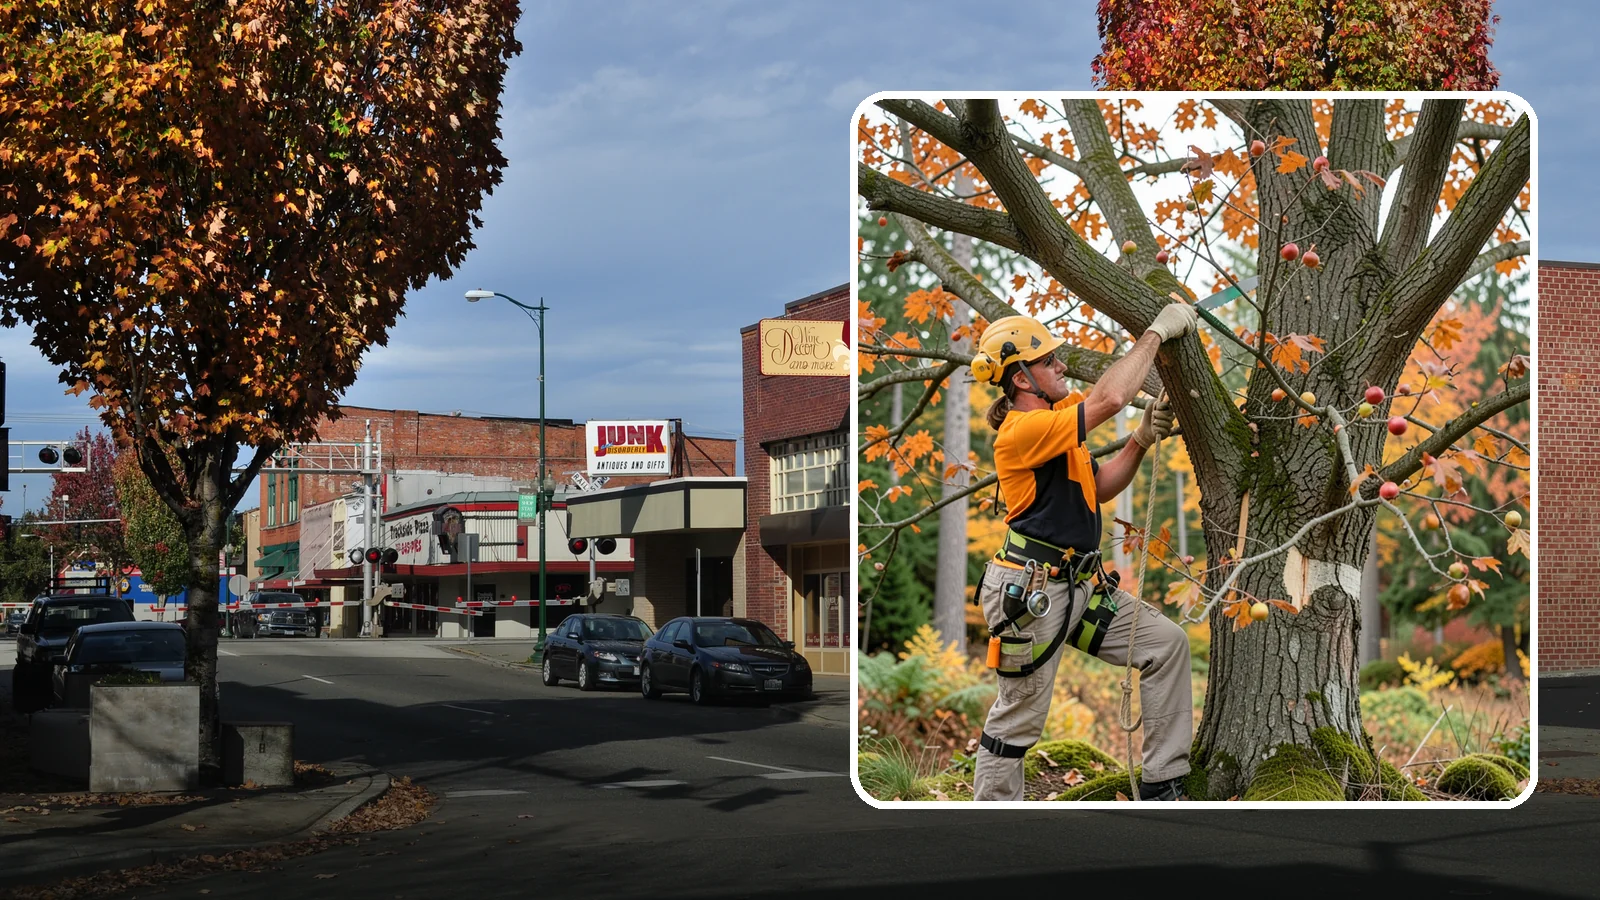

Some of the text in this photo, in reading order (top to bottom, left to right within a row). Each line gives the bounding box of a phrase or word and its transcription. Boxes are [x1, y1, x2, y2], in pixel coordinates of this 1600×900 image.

[765, 327, 831, 366] Decor
[595, 425, 665, 457] JUNK
[597, 461, 665, 470] ANTIQUES AND GIFTS
[390, 519, 429, 540] Trackside Pizza
